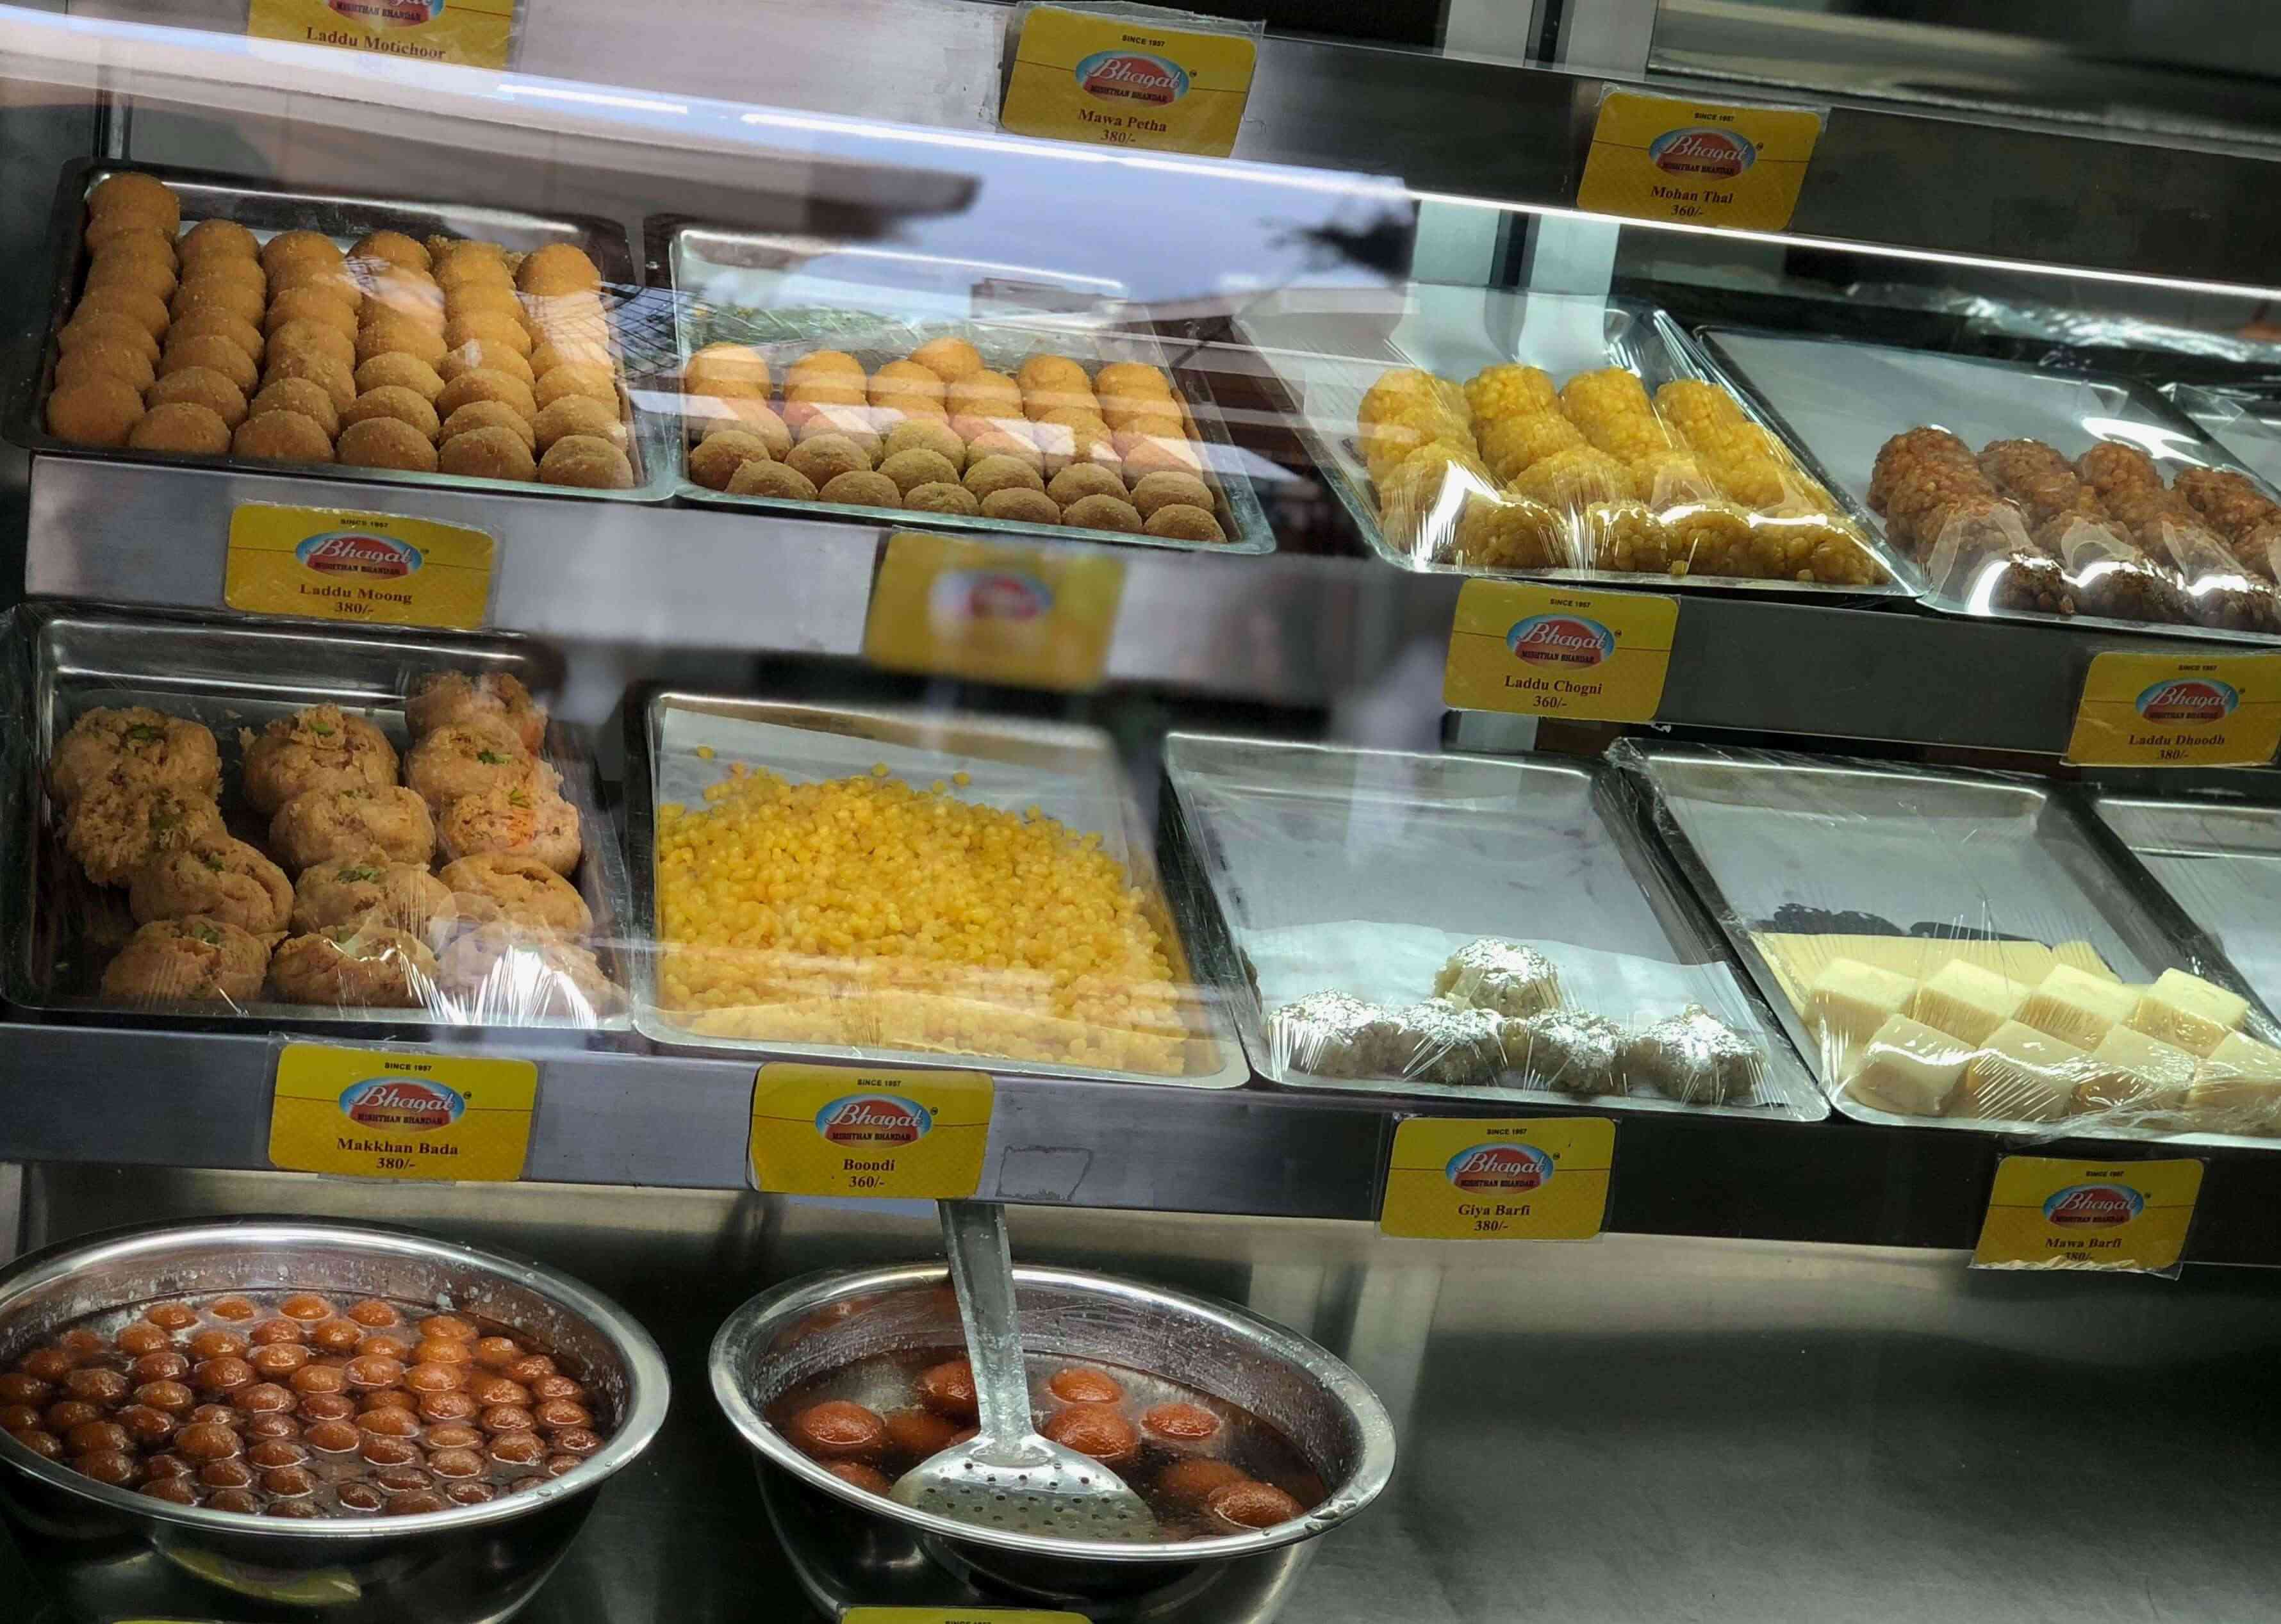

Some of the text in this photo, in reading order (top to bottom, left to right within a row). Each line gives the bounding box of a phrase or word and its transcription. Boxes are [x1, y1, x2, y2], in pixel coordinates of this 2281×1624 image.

[306, 26, 446, 60] Laddu Motichoor
[1122, 34, 1146, 45] SINCE
[1086, 58, 1181, 88] Bhagat
[1077, 108, 1167, 133] Mawa Petha
[1694, 112, 1717, 121] SINCE
[1100, 129, 1136, 144] 380/-
[1661, 135, 1748, 161] Bhagat
[1651, 185, 1734, 204] Mohan Thal
[1671, 204, 1704, 217] 360/-
[340, 518, 368, 527] SINCE
[309, 539, 412, 564] Bhagat
[299, 583, 413, 605] Laddu Moong
[334, 601, 374, 614] 380/-
[1550, 598, 1572, 607] SINCE
[1517, 622, 1607, 650] Bhagat
[1504, 675, 1603, 697] Laddu Chogni
[1533, 695, 1568, 709] 360/-
[2148, 686, 2230, 708] Bhagat
[2128, 734, 2225, 746] Laddu Dhoodh
[384, 1062, 411, 1071] SINCE
[857, 1078, 882, 1087] SINCE
[350, 1086, 455, 1113] Bhagat
[825, 1104, 923, 1130] Bhagat
[337, 1137, 459, 1155] Makkhan Bada
[376, 1157, 416, 1170] 380/-
[843, 1158, 896, 1172] Boondi
[1455, 1152, 1545, 1177] Bhagat
[848, 1176, 885, 1188] 360/-
[2052, 1191, 2137, 1213] Bhagat
[1458, 1203, 1531, 1217] Giya Barfi
[1474, 1220, 1508, 1232] 380/-
[2045, 1238, 2123, 1249] Mawa Barfi
